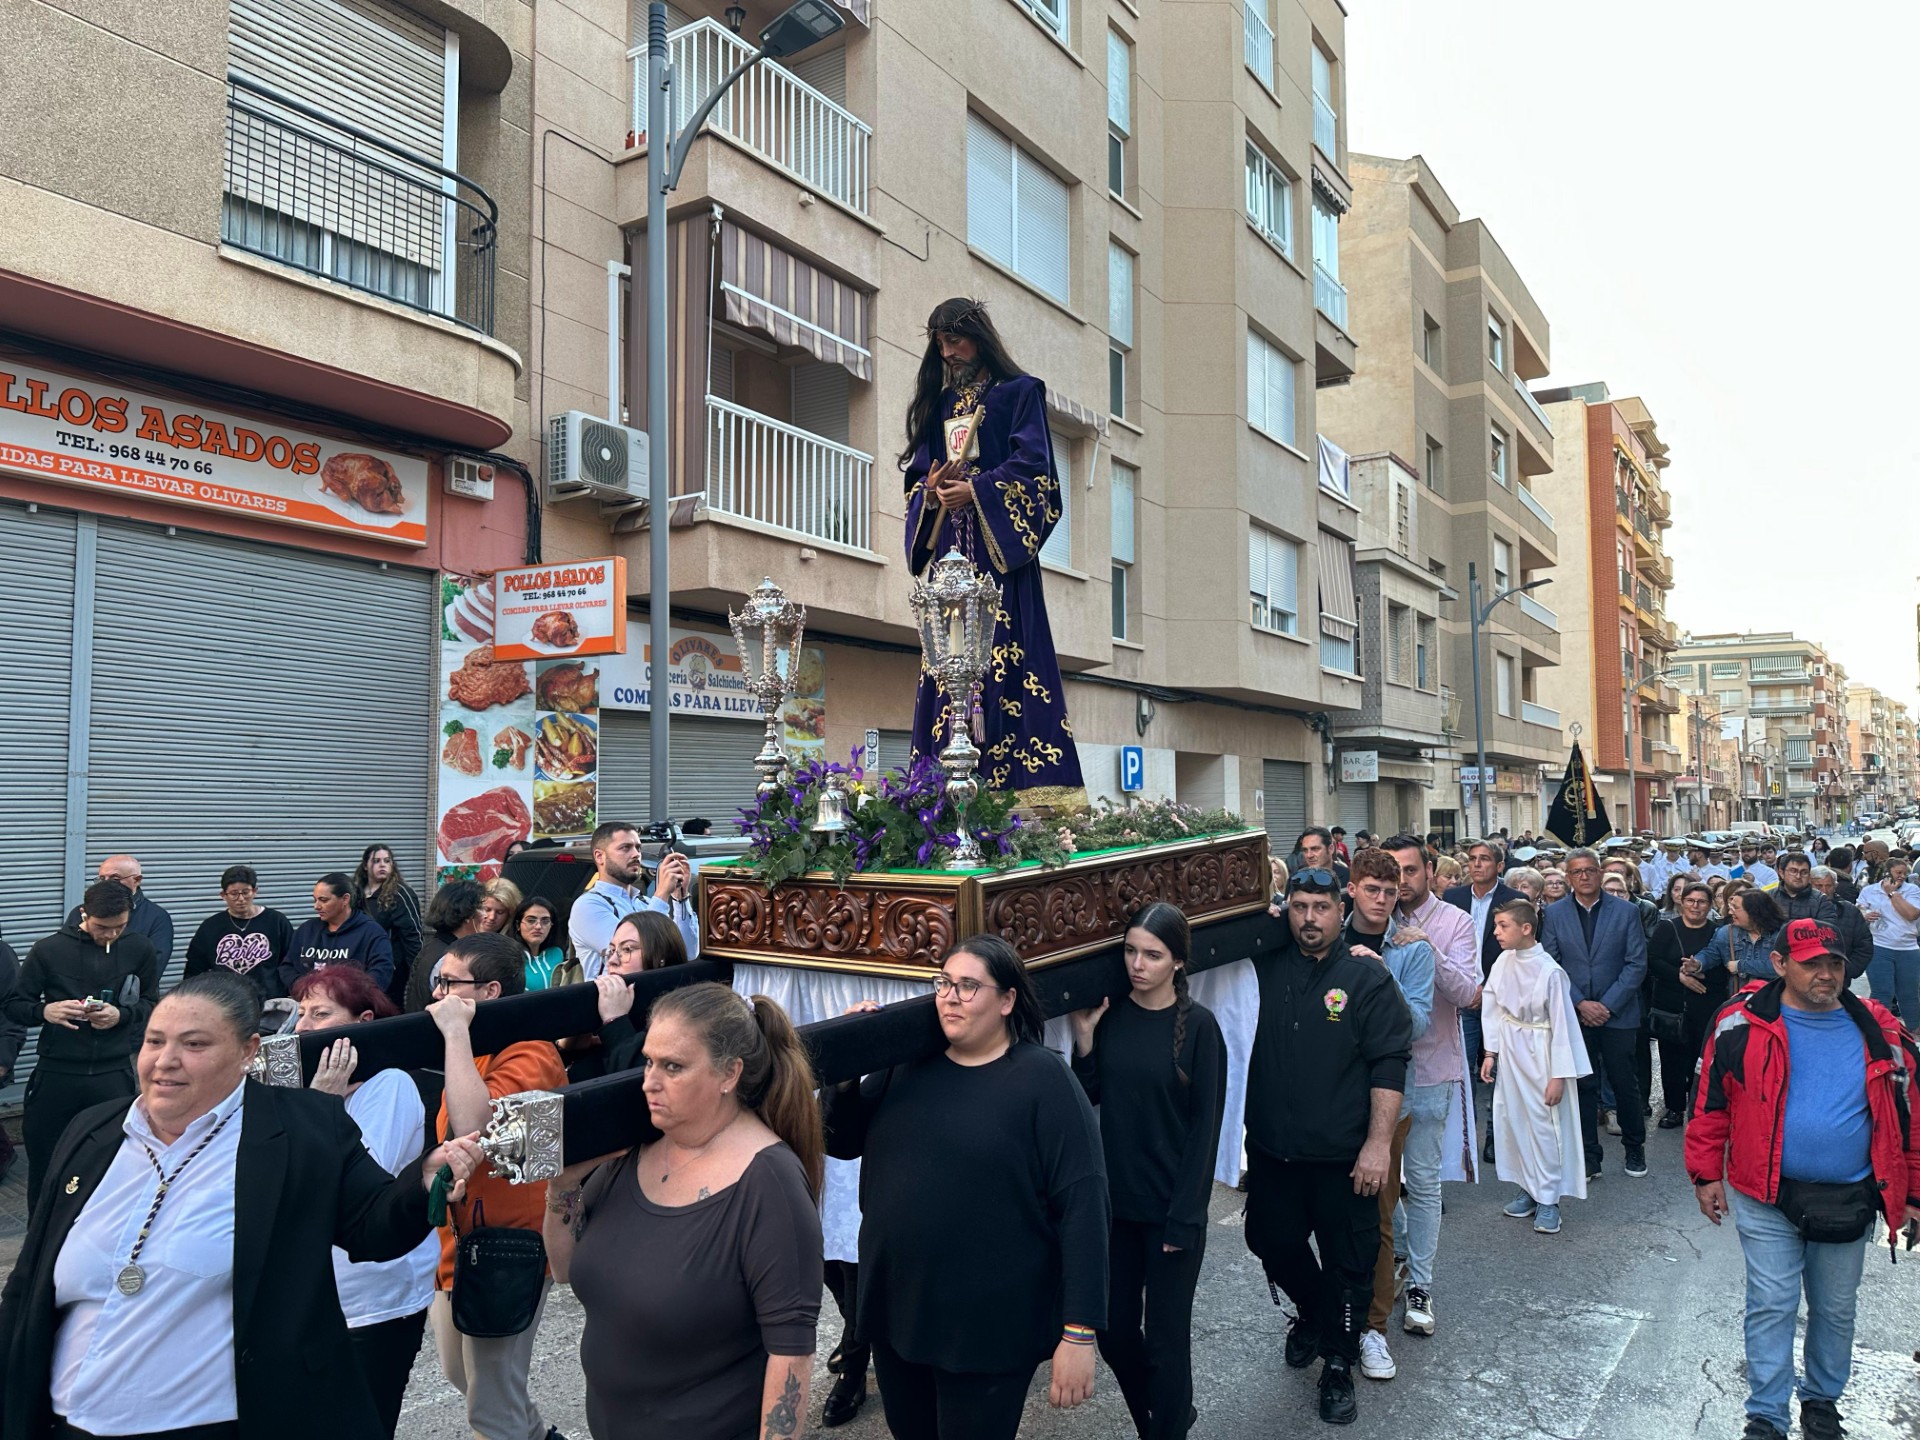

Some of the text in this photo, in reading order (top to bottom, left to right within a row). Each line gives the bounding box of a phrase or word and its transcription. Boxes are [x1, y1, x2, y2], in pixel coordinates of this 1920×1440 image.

[56, 430, 213, 475] TEL: 968 44 70 66
[136, 405, 322, 475] ASADOS
[59, 459, 116, 481] PARA
[120, 470, 195, 496] LLEVAR
[200, 485, 287, 512] OLIVARES
[504, 565, 605, 592] POLLOS ASADOS
[522, 588, 586, 600] TEL: 968 44 70 66
[502, 599, 607, 615] COMIDAS PARA LLEVAR OLIVARES
[673, 639, 723, 666] OLIVARES
[684, 693, 721, 710] PARA
[1127, 751, 1140, 786] P
[1343, 756, 1361, 766] BAR
[217, 939, 271, 963] Barbie
[300, 946, 349, 960] LONDON
